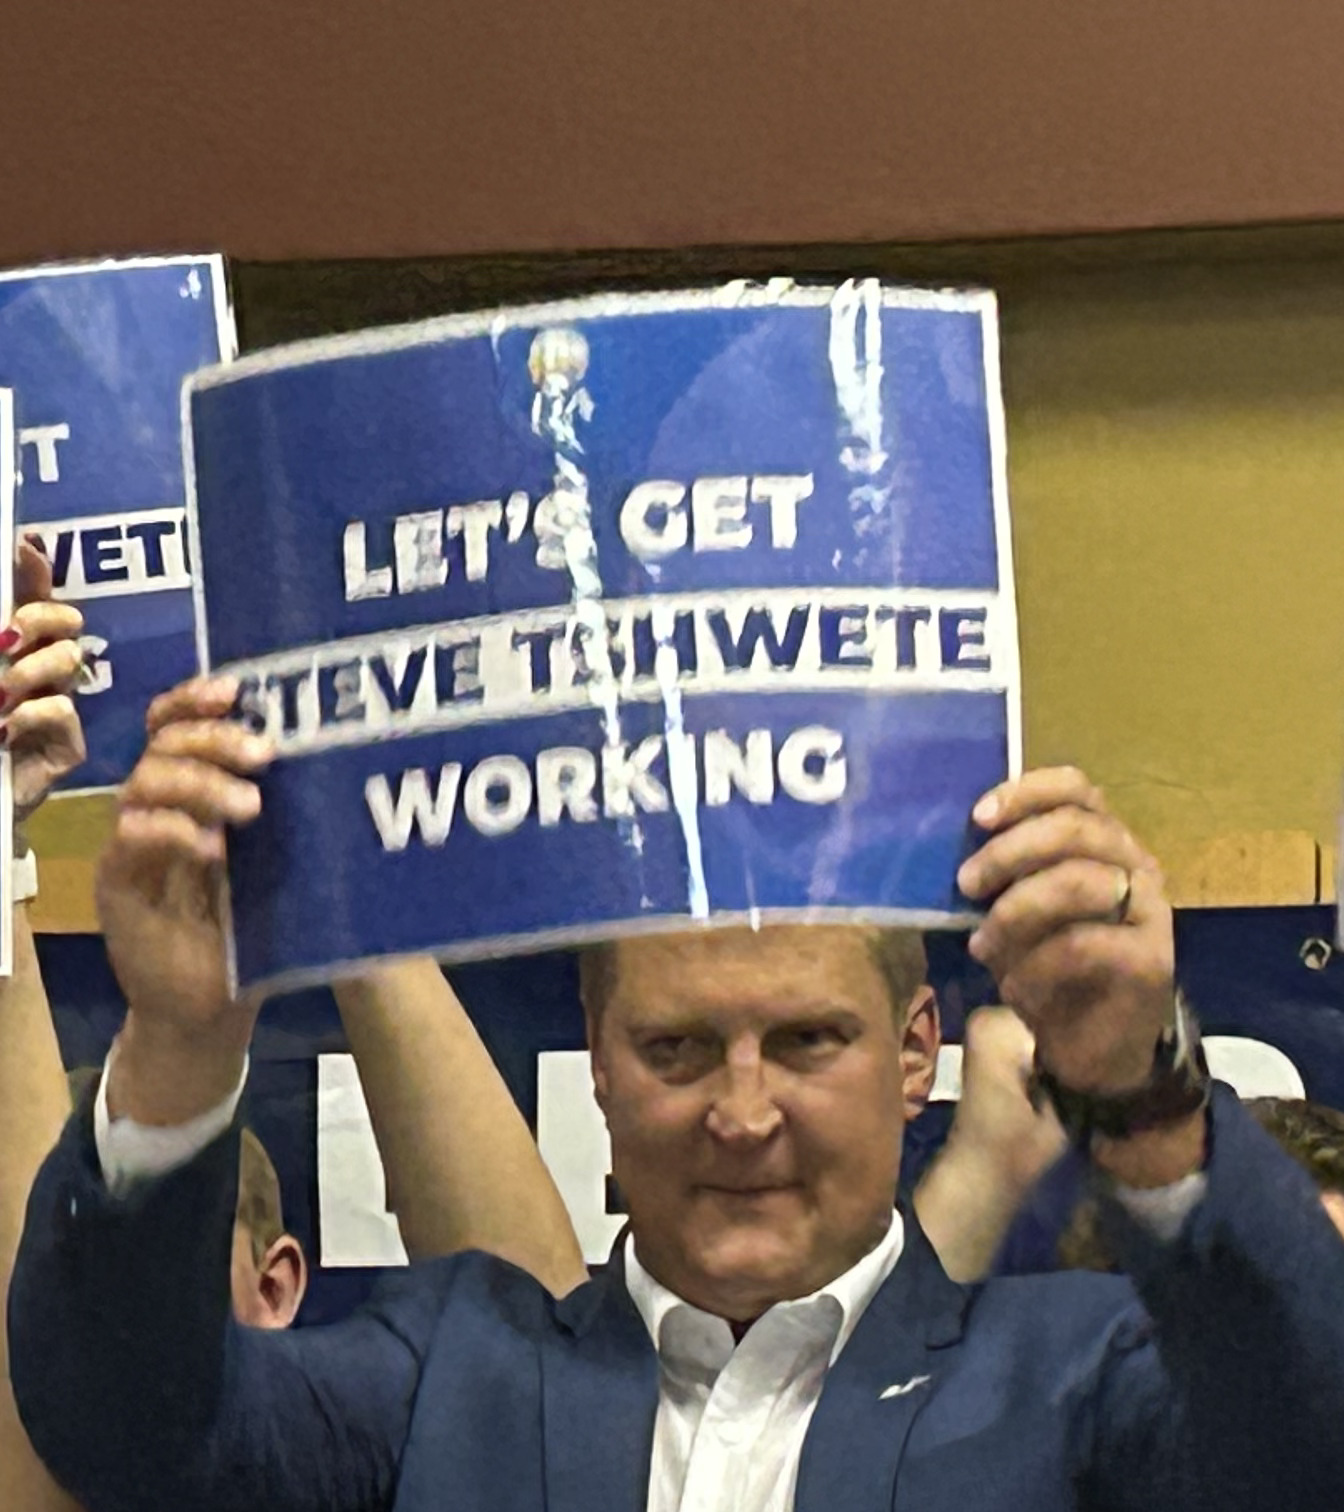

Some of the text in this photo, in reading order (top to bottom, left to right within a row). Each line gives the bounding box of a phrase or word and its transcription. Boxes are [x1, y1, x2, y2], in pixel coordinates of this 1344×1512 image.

[343, 472, 813, 602] LET'S GET
[234, 637, 485, 734] STEVE
[364, 724, 848, 852] WORKING
